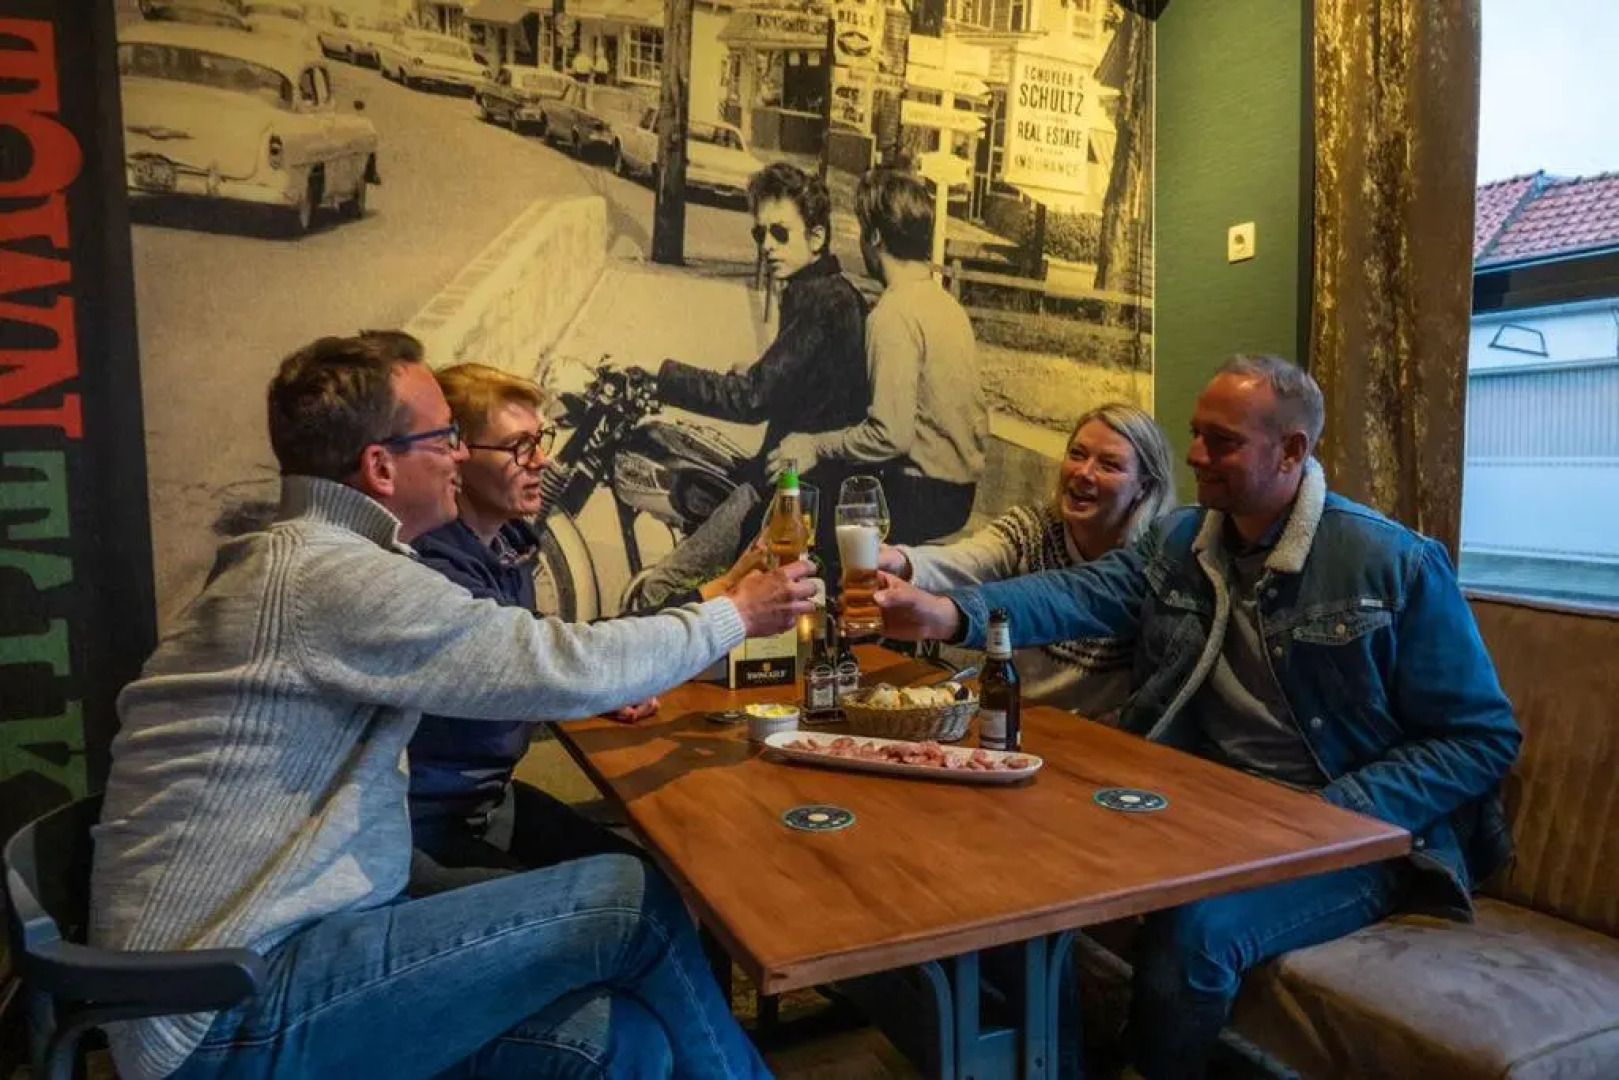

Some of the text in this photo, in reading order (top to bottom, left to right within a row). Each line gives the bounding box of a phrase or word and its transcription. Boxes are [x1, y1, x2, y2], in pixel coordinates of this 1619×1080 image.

[1019, 83, 1084, 116] SCHULTZ
[1017, 121, 1082, 149] REAL ESTATE
